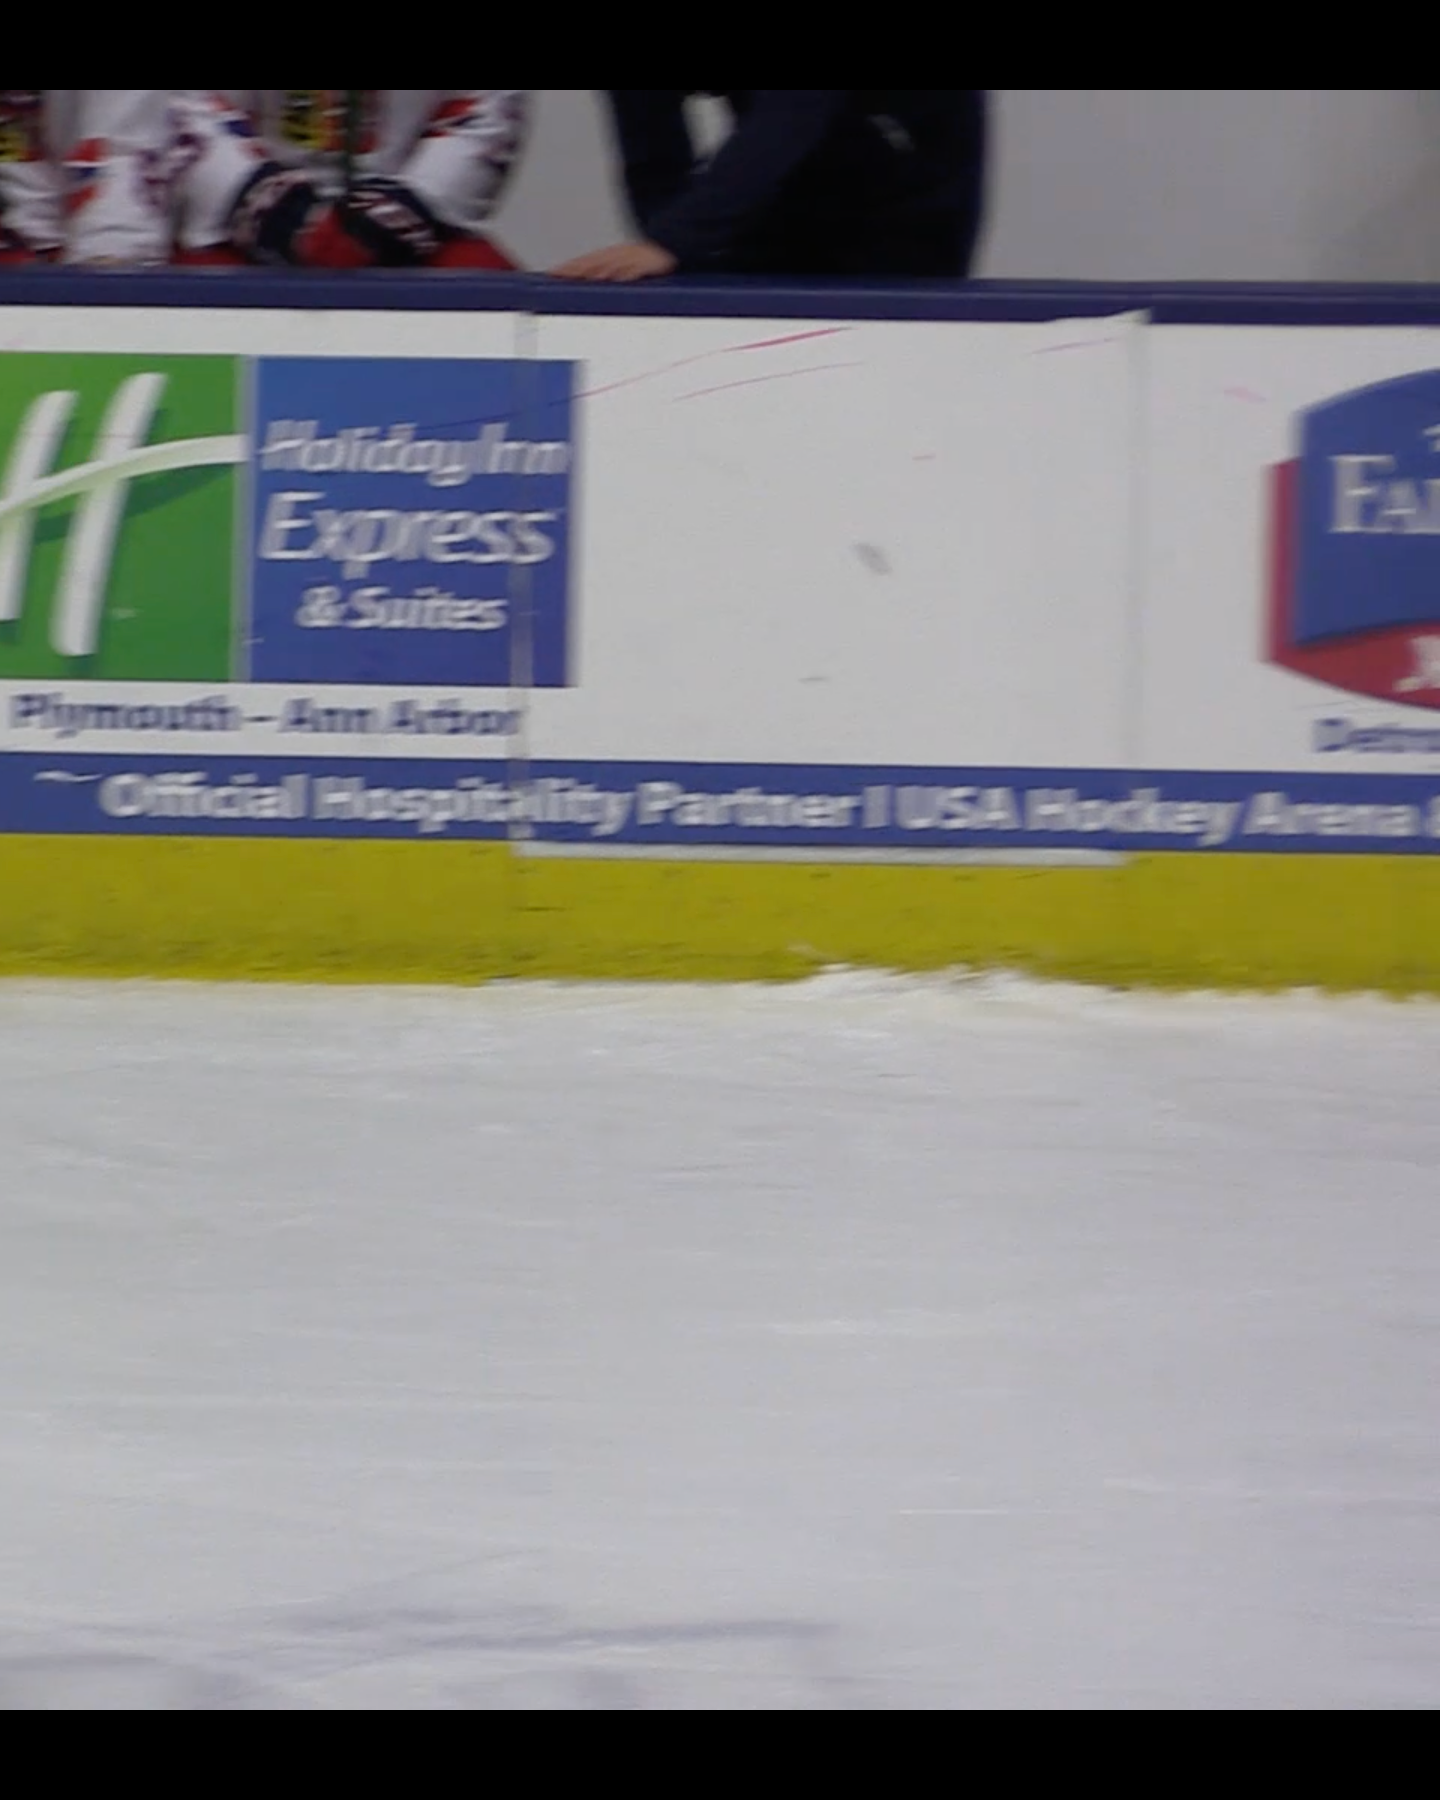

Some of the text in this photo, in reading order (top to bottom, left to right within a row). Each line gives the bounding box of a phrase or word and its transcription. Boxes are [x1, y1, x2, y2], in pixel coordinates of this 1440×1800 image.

[262, 420, 570, 487] Holiday Inn
[260, 491, 556, 579] Express
[295, 586, 508, 629] & Suites
[9, 692, 242, 737] Plymouth
[278, 697, 380, 735] Ann
[385, 698, 523, 737] Arbor
[98, 772, 308, 819] Official
[311, 776, 633, 836] Hospitality
[635, 781, 860, 828] Partner
[894, 786, 1021, 831] USA
[1024, 787, 1240, 847] Hockey
[1242, 791, 1420, 837] Arena
